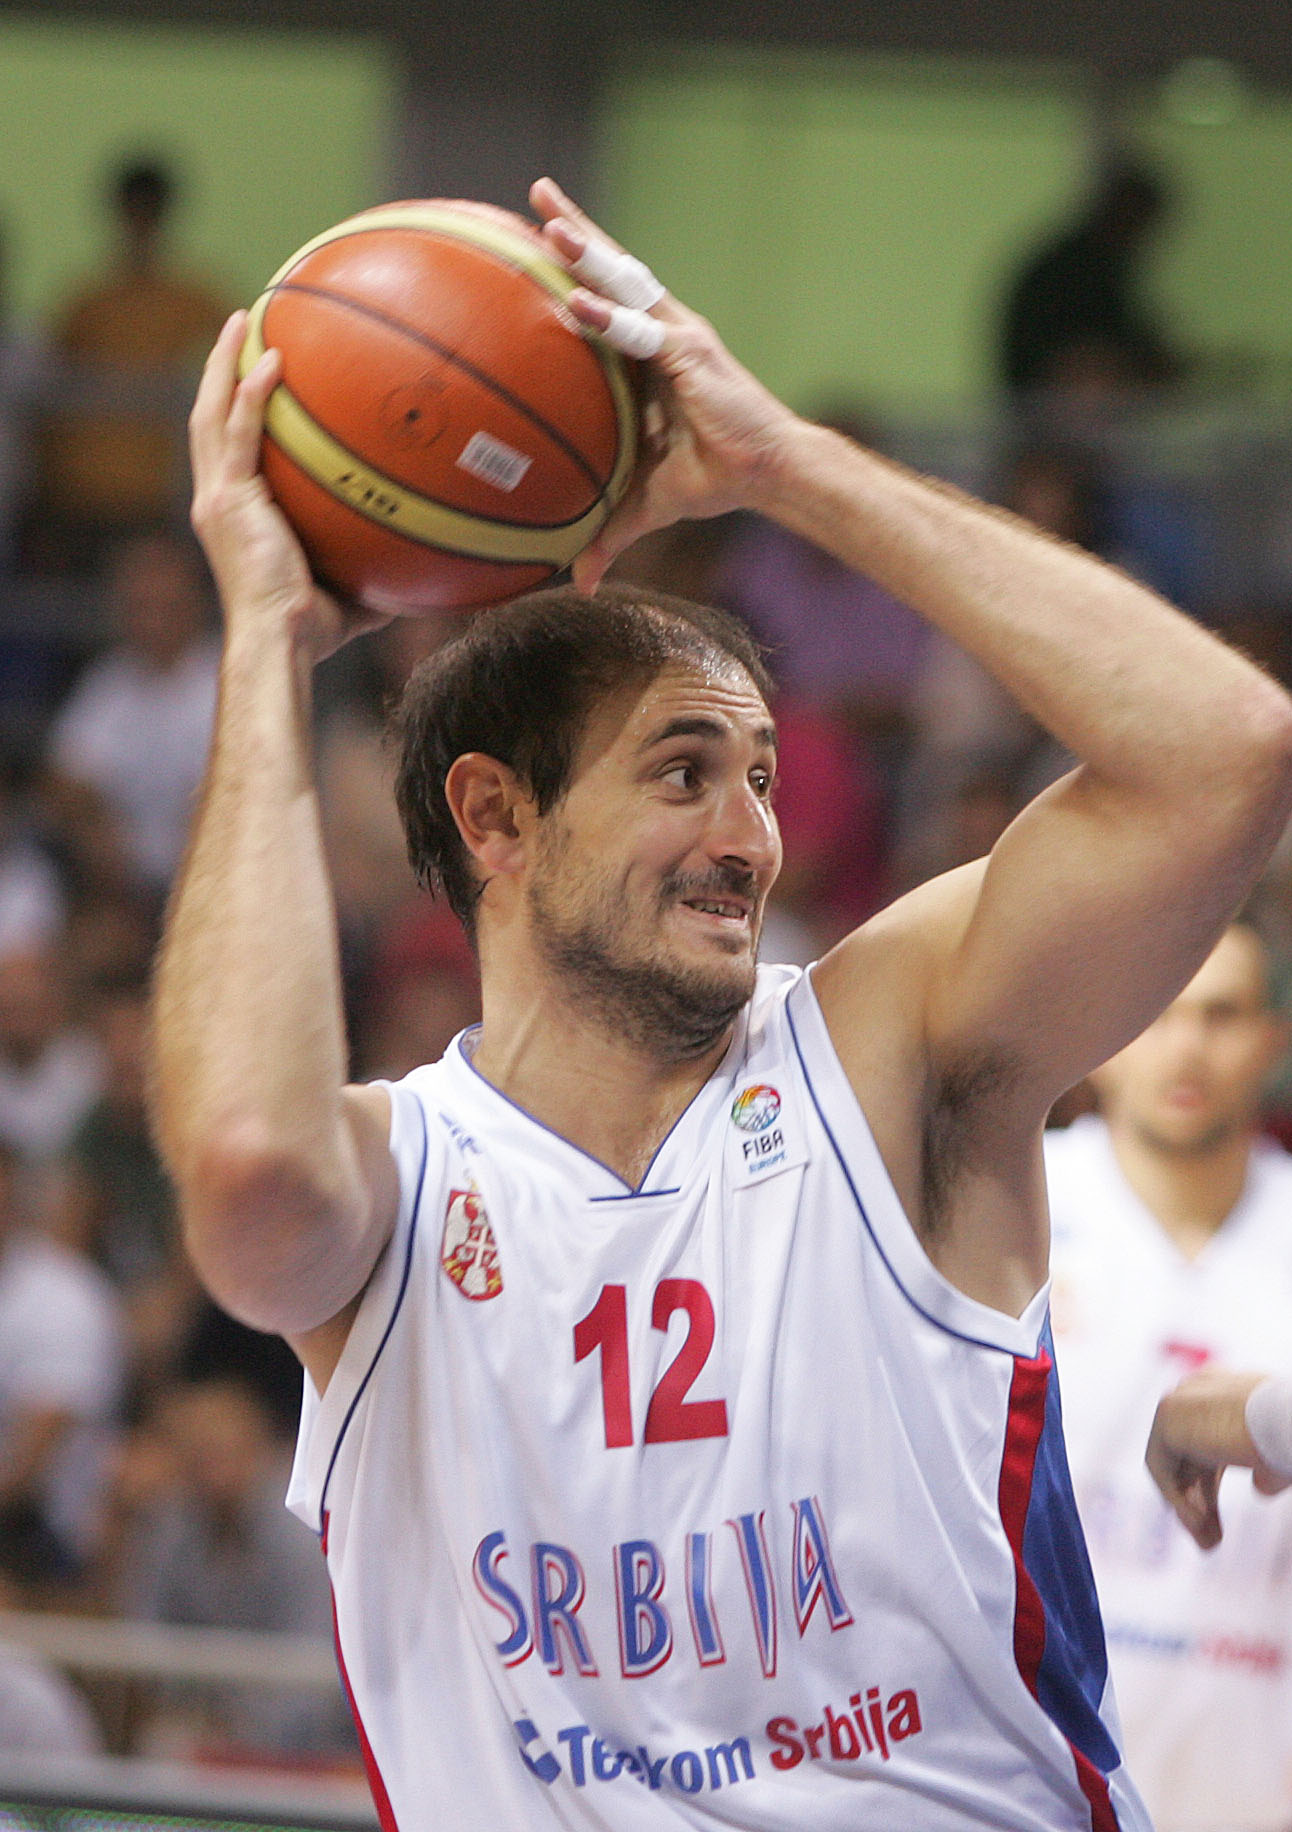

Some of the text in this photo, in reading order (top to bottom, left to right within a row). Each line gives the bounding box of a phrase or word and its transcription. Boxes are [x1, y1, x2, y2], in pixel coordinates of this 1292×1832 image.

[742, 1128, 784, 1160] FIBA
[573, 1277, 729, 1449] 12
[765, 1685, 924, 1773] Srbija
